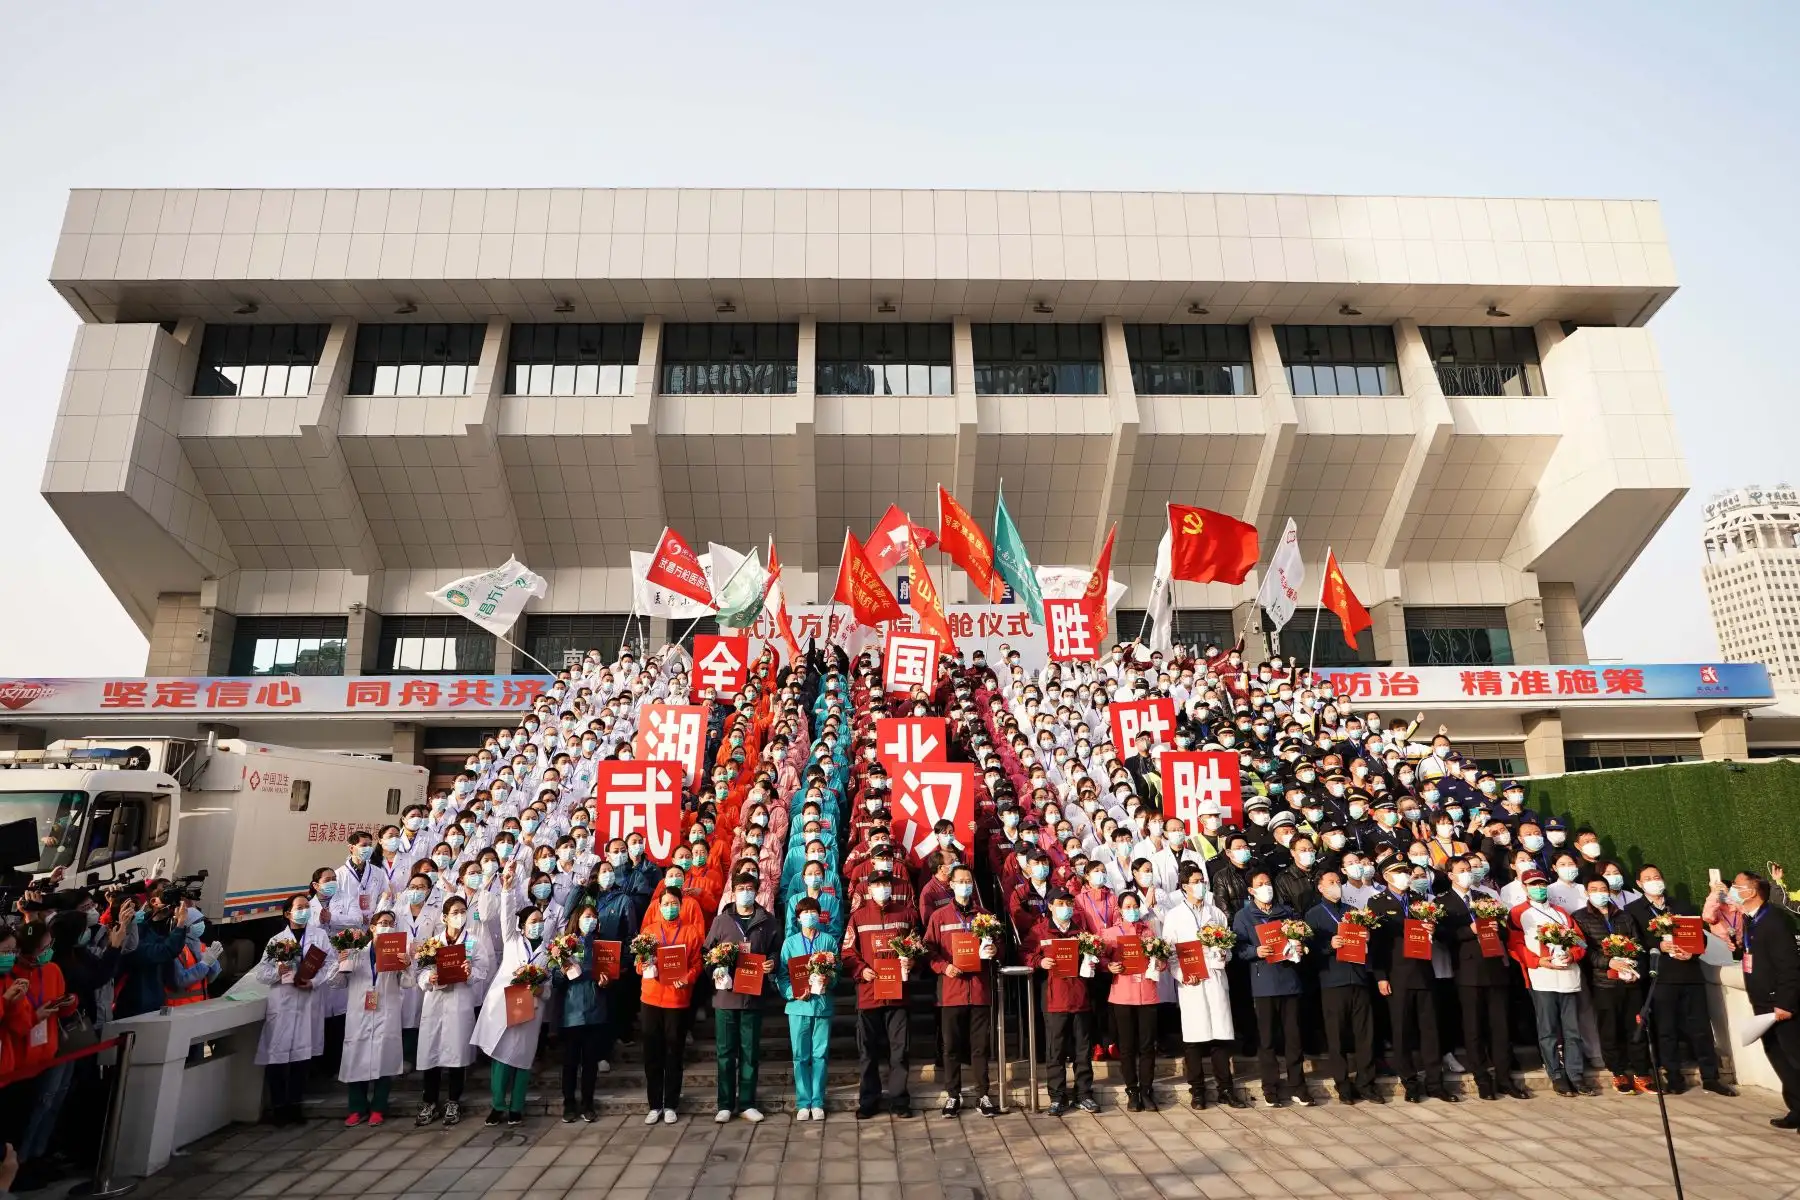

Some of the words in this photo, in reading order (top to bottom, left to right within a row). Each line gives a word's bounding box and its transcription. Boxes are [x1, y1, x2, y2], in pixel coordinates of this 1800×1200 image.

[1050, 602, 1095, 657] 胜
[100, 680, 302, 708] 坚定信心
[346, 679, 547, 708] 同舟共济
[698, 640, 742, 699] 全
[887, 636, 937, 695] 国
[1459, 667, 1648, 697] 精准施策
[644, 709, 702, 790] 湖
[884, 723, 938, 763] 北
[1118, 703, 1171, 760] 胜
[262, 771, 290, 787] 中国卫生
[1172, 757, 1232, 840] 胜
[603, 766, 674, 859] 武
[900, 768, 965, 861] 汉
